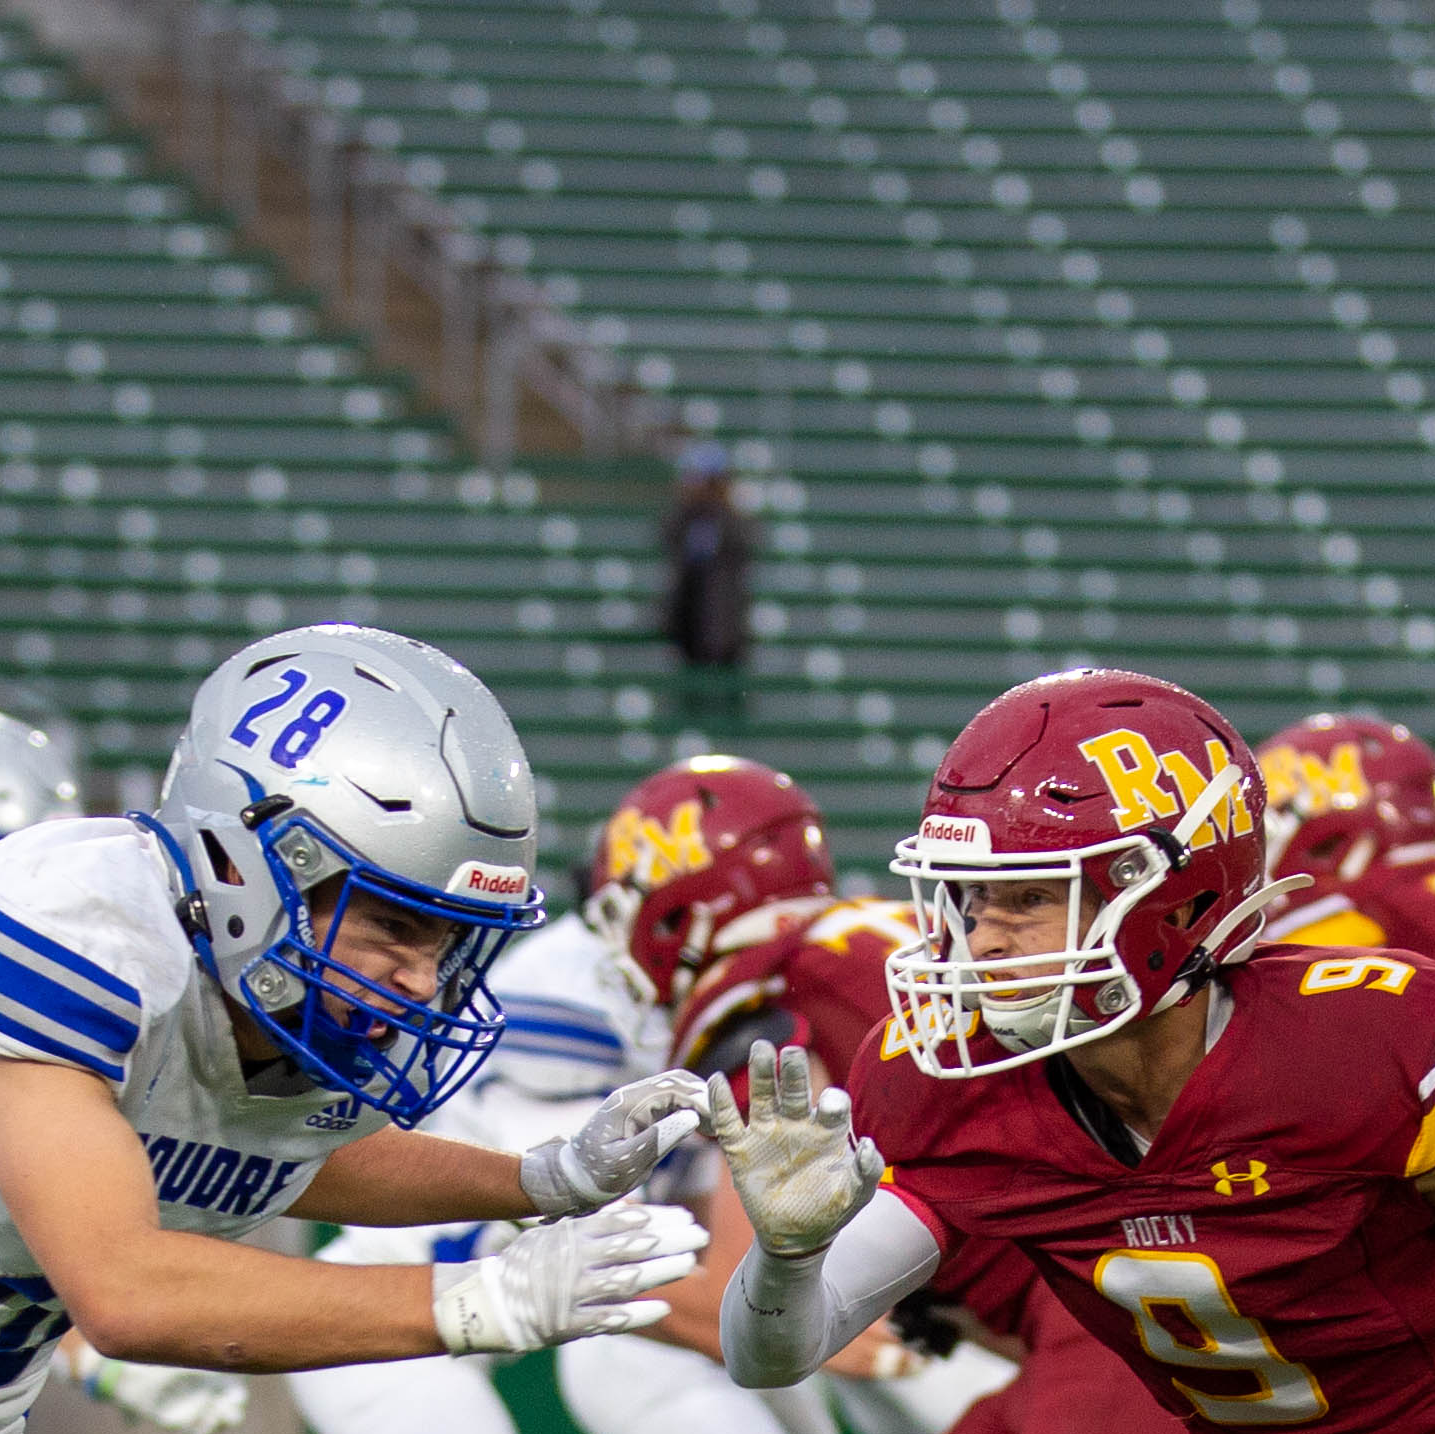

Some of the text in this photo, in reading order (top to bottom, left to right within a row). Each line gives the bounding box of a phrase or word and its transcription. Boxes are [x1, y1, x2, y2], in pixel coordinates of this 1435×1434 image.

[229, 668, 346, 768] 28
[1077, 728, 1254, 850] RM
[922, 821, 976, 842] Riddell
[1299, 957, 1416, 996] 9
[137, 1132, 303, 1216] OUDRE
[1120, 1214, 1197, 1248] ROCKY
[1093, 1249, 1329, 1425] 9
